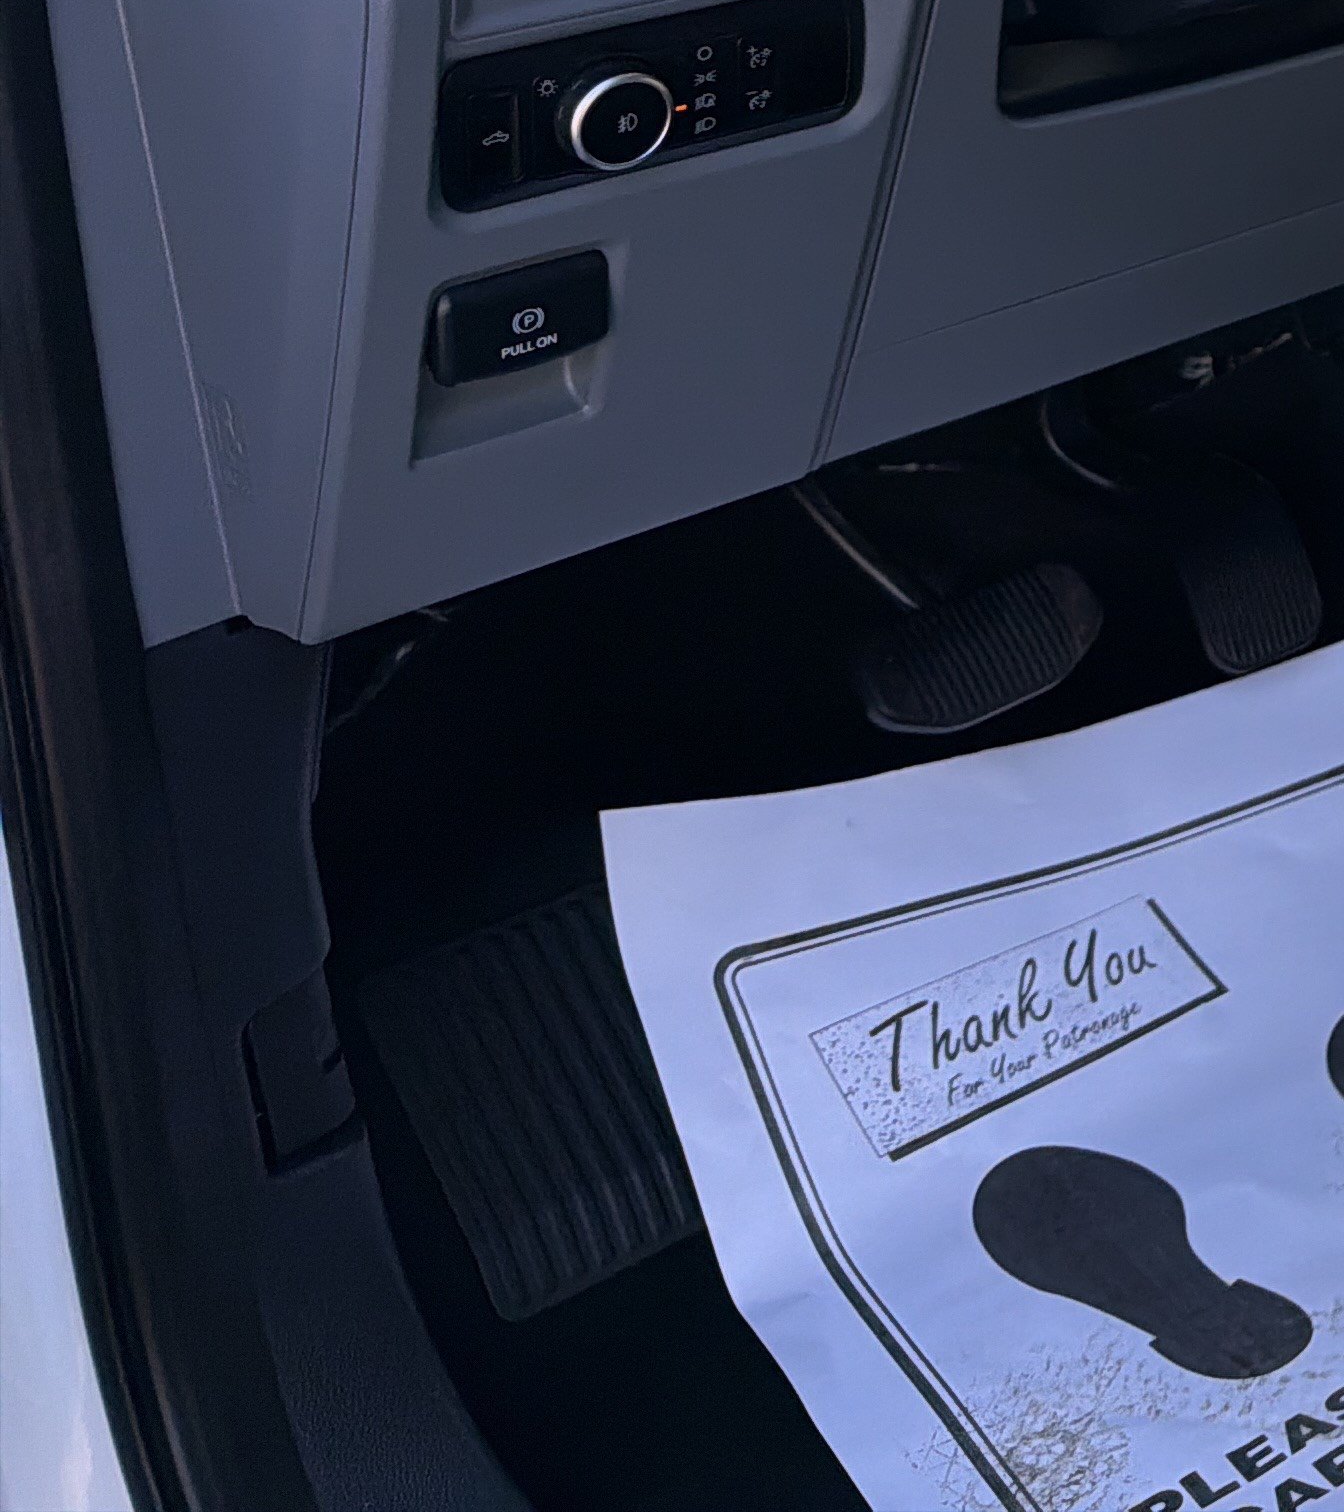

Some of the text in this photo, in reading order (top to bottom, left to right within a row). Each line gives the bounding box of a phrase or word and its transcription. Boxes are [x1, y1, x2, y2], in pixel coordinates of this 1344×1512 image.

[501, 332, 558, 359] PULL ON
[870, 928, 1158, 1092] Thank You
[947, 1000, 1143, 1105] For Your Patronage
